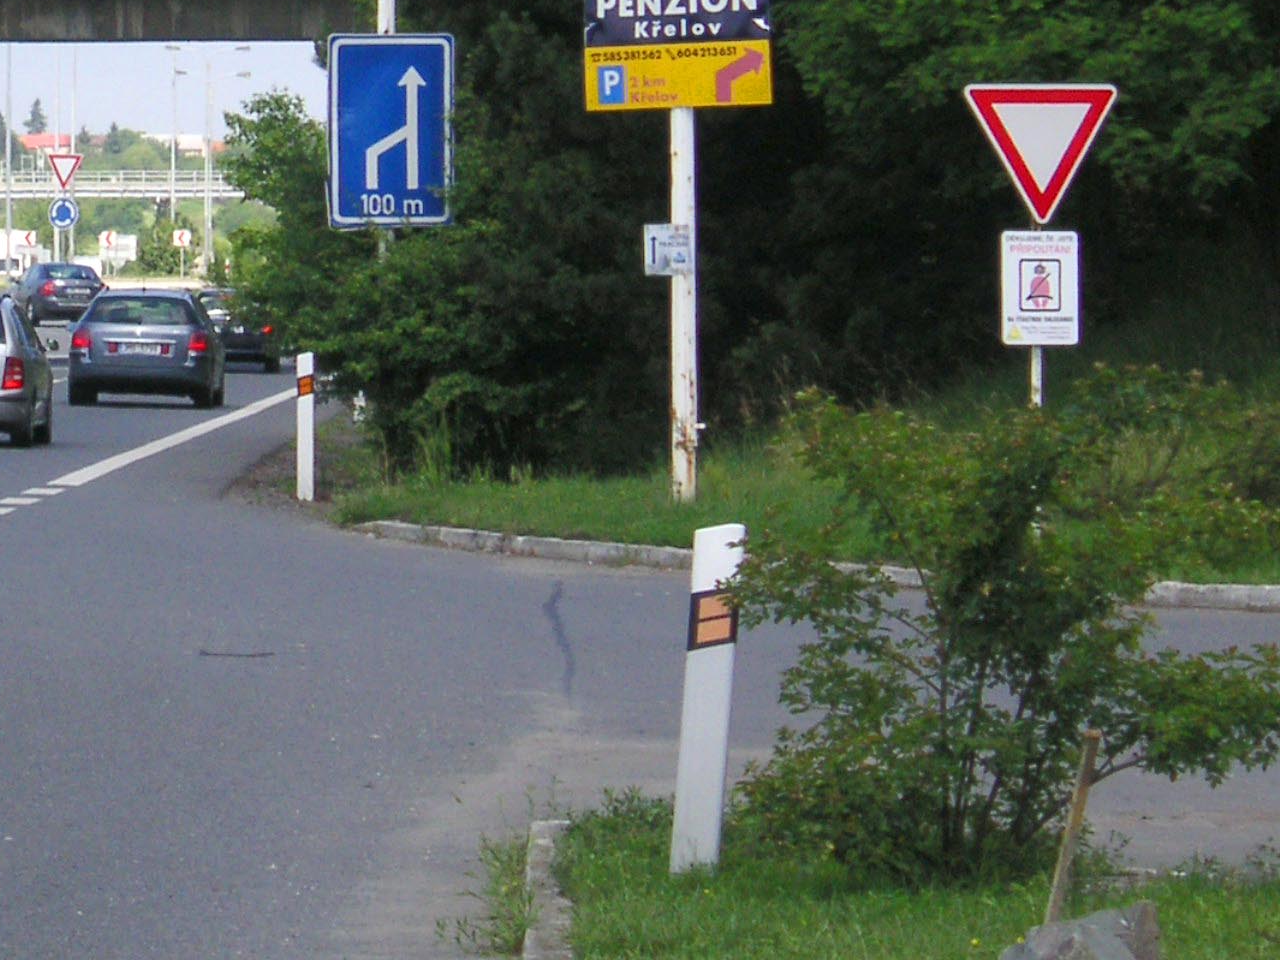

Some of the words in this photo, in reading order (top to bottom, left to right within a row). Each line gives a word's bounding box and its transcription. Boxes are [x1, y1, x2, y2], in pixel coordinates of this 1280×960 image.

[634, 19, 722, 39] Křelov
[604, 70, 620, 96] P
[643, 74, 666, 87] km
[360, 194, 395, 215] 100
[403, 198, 424, 215] m
